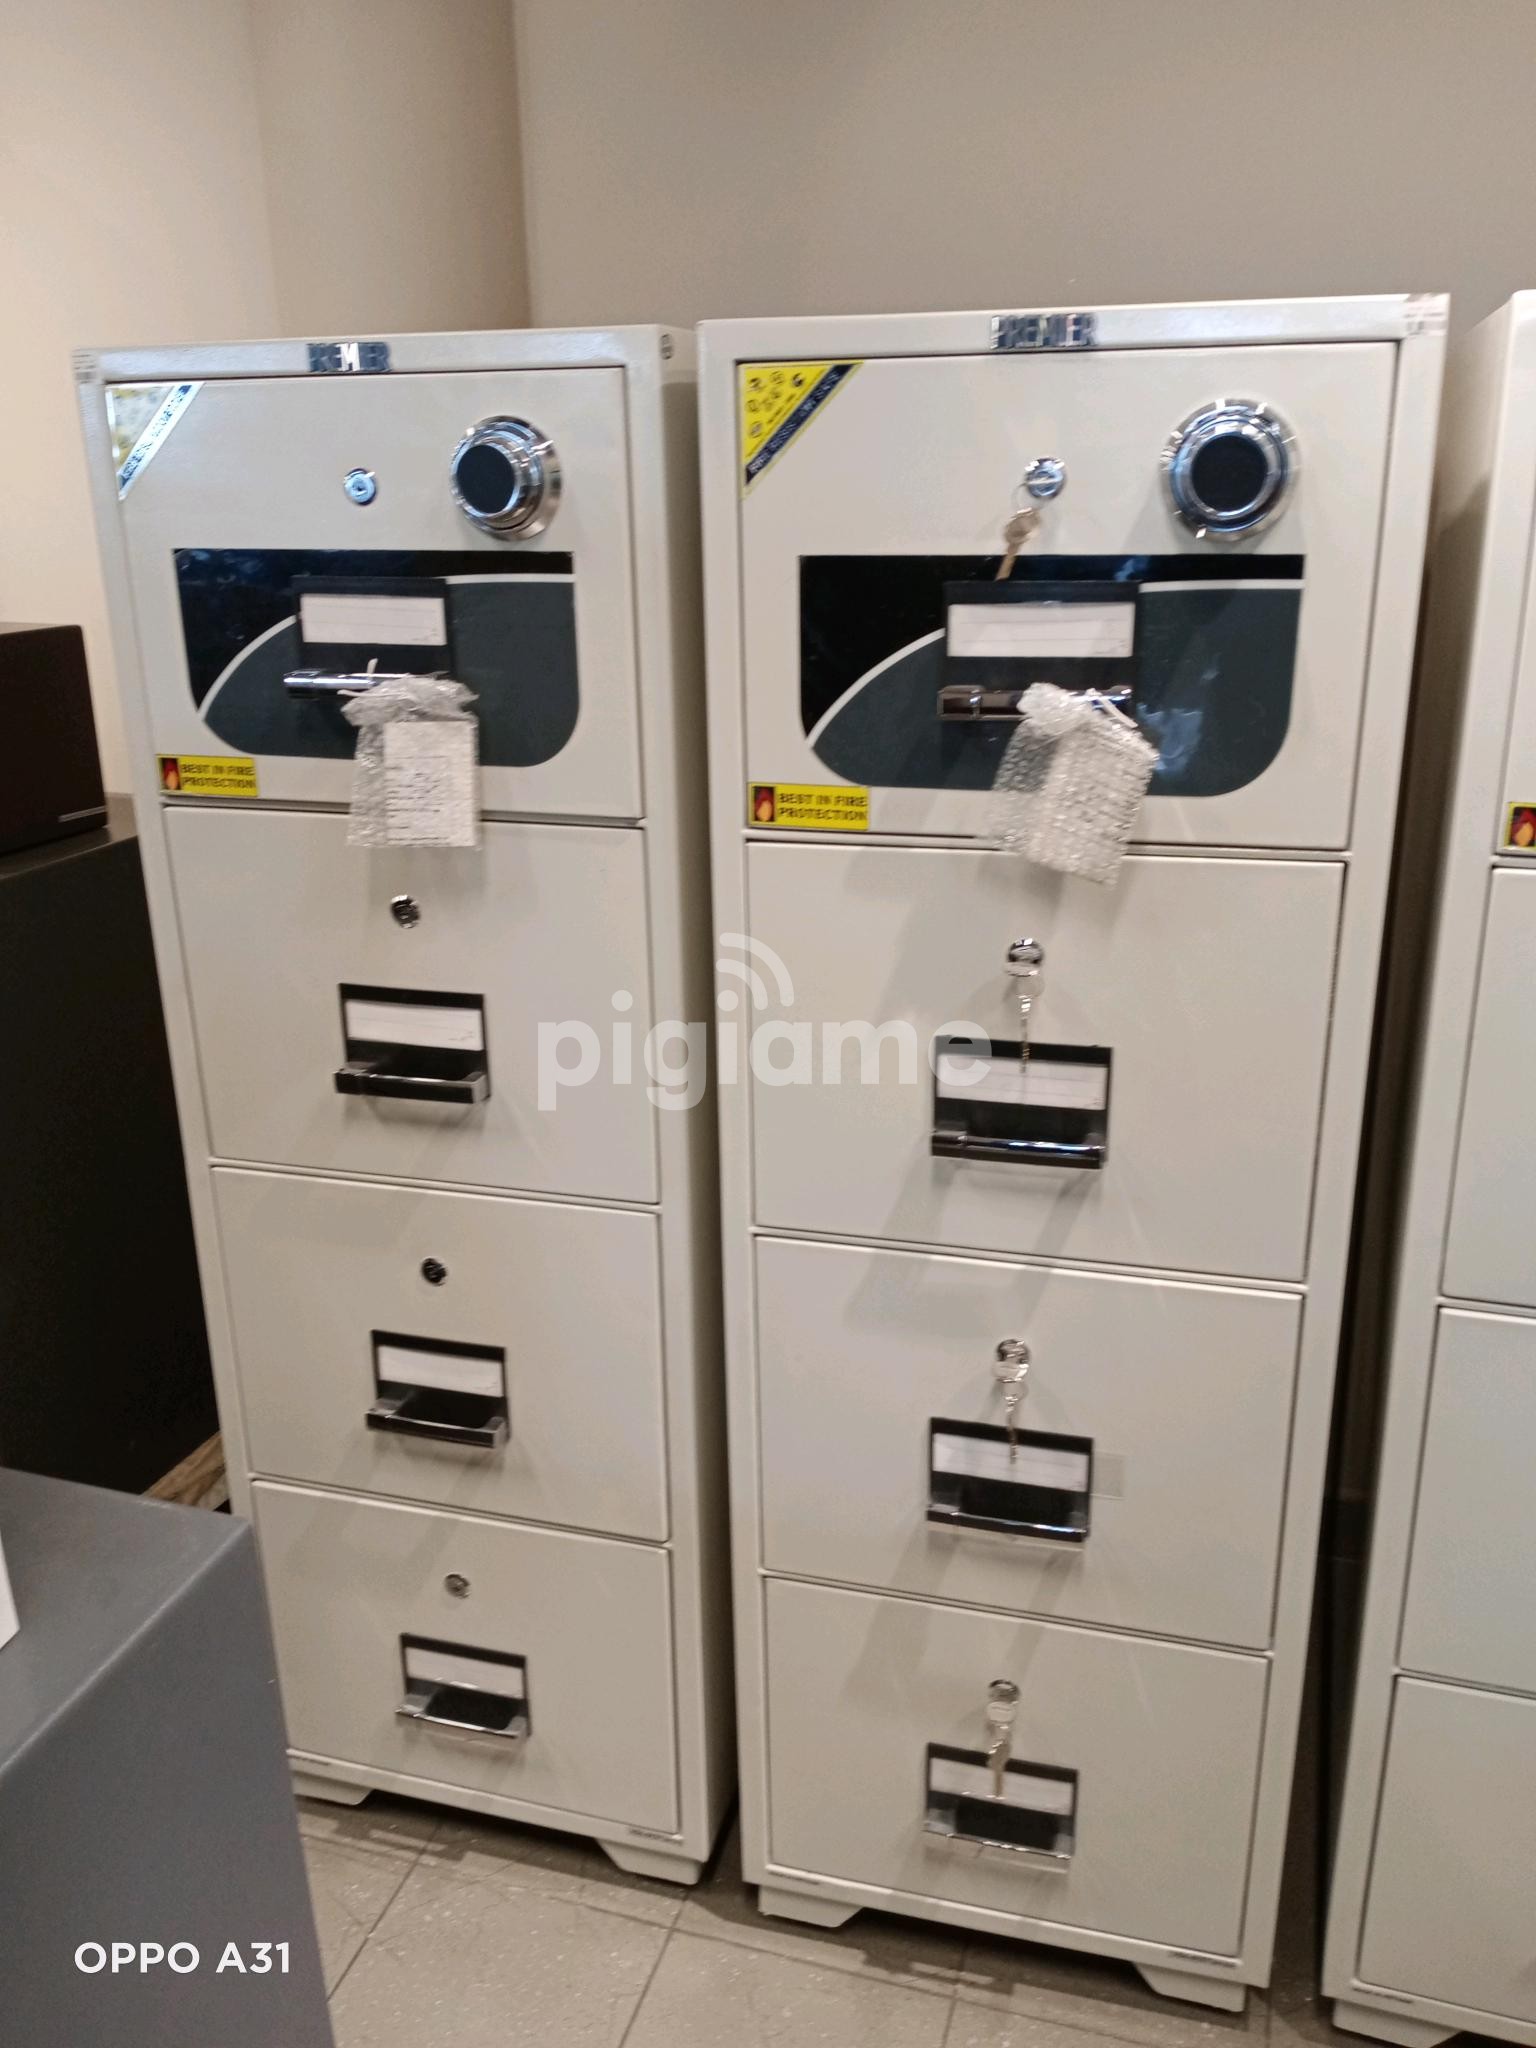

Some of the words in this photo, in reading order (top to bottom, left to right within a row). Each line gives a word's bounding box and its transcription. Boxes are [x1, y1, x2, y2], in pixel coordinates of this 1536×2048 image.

[182, 764, 210, 774] BEST
[212, 766, 224, 774] IN
[228, 766, 255, 776] FIRE
[182, 777, 256, 788] PROTECTION
[779, 792, 812, 804] BEST
[816, 795, 831, 805] IN
[835, 796, 867, 807] FIRE
[779, 807, 867, 820] PROTECTION
